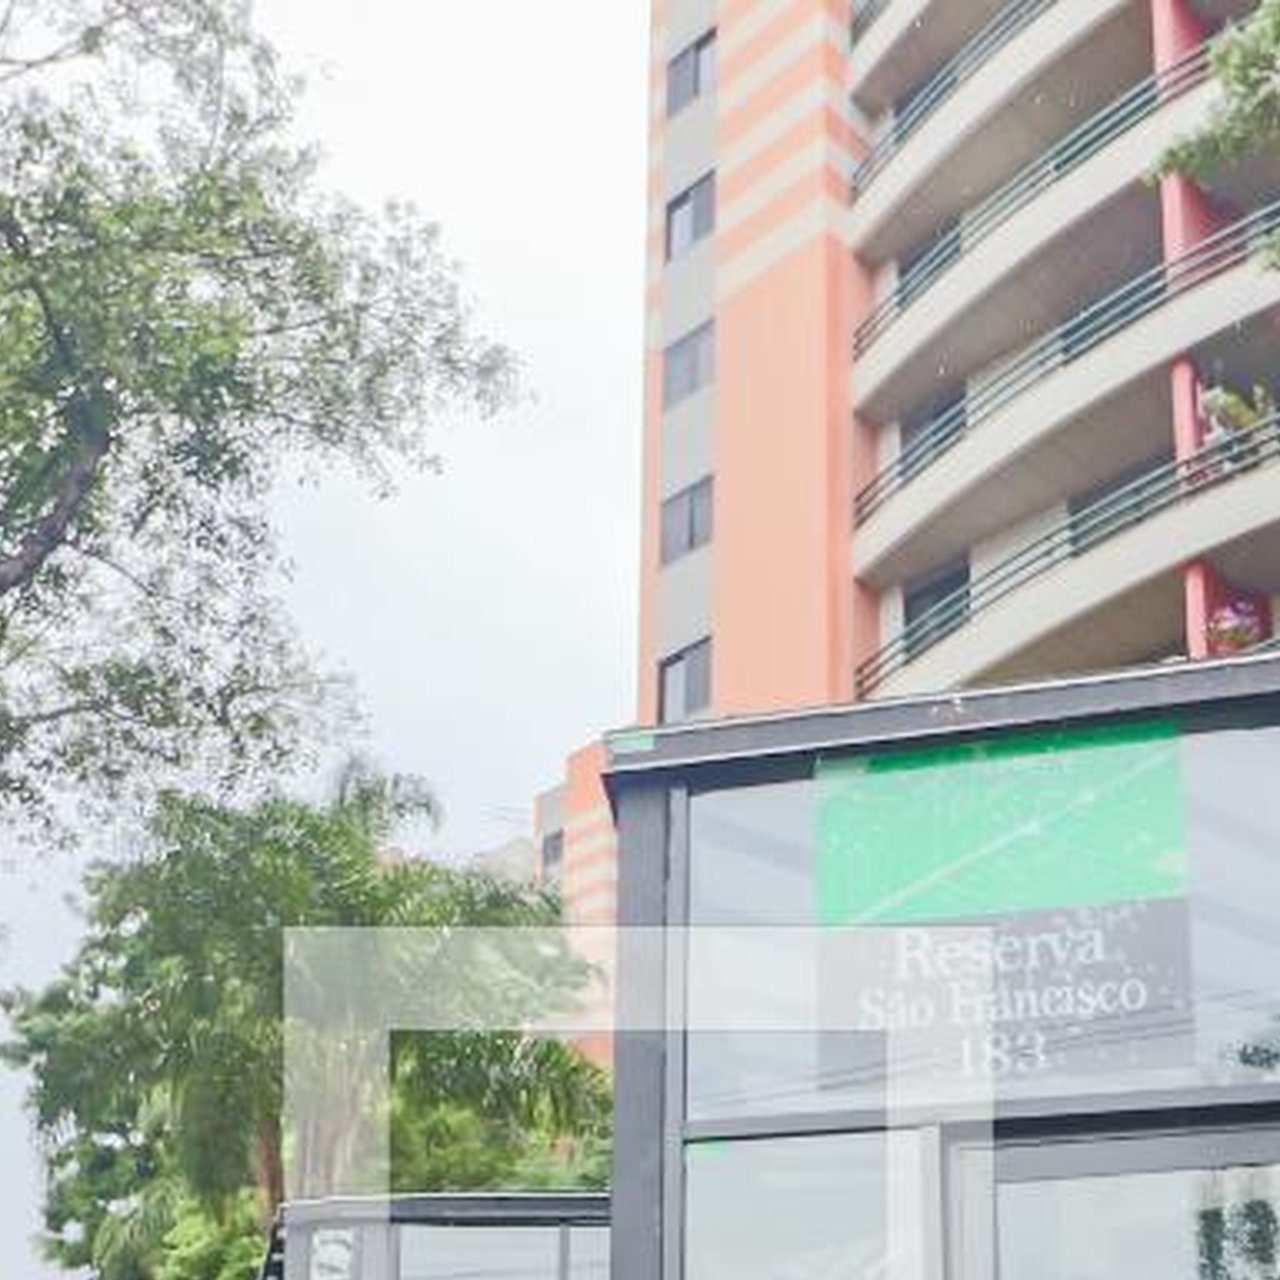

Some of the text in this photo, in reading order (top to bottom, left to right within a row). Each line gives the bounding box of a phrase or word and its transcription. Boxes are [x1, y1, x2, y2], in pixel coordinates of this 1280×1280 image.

[898, 928, 1105, 979] Reserva
[949, 974, 1148, 1026] Francisco
[963, 1033, 1046, 1076] 183
